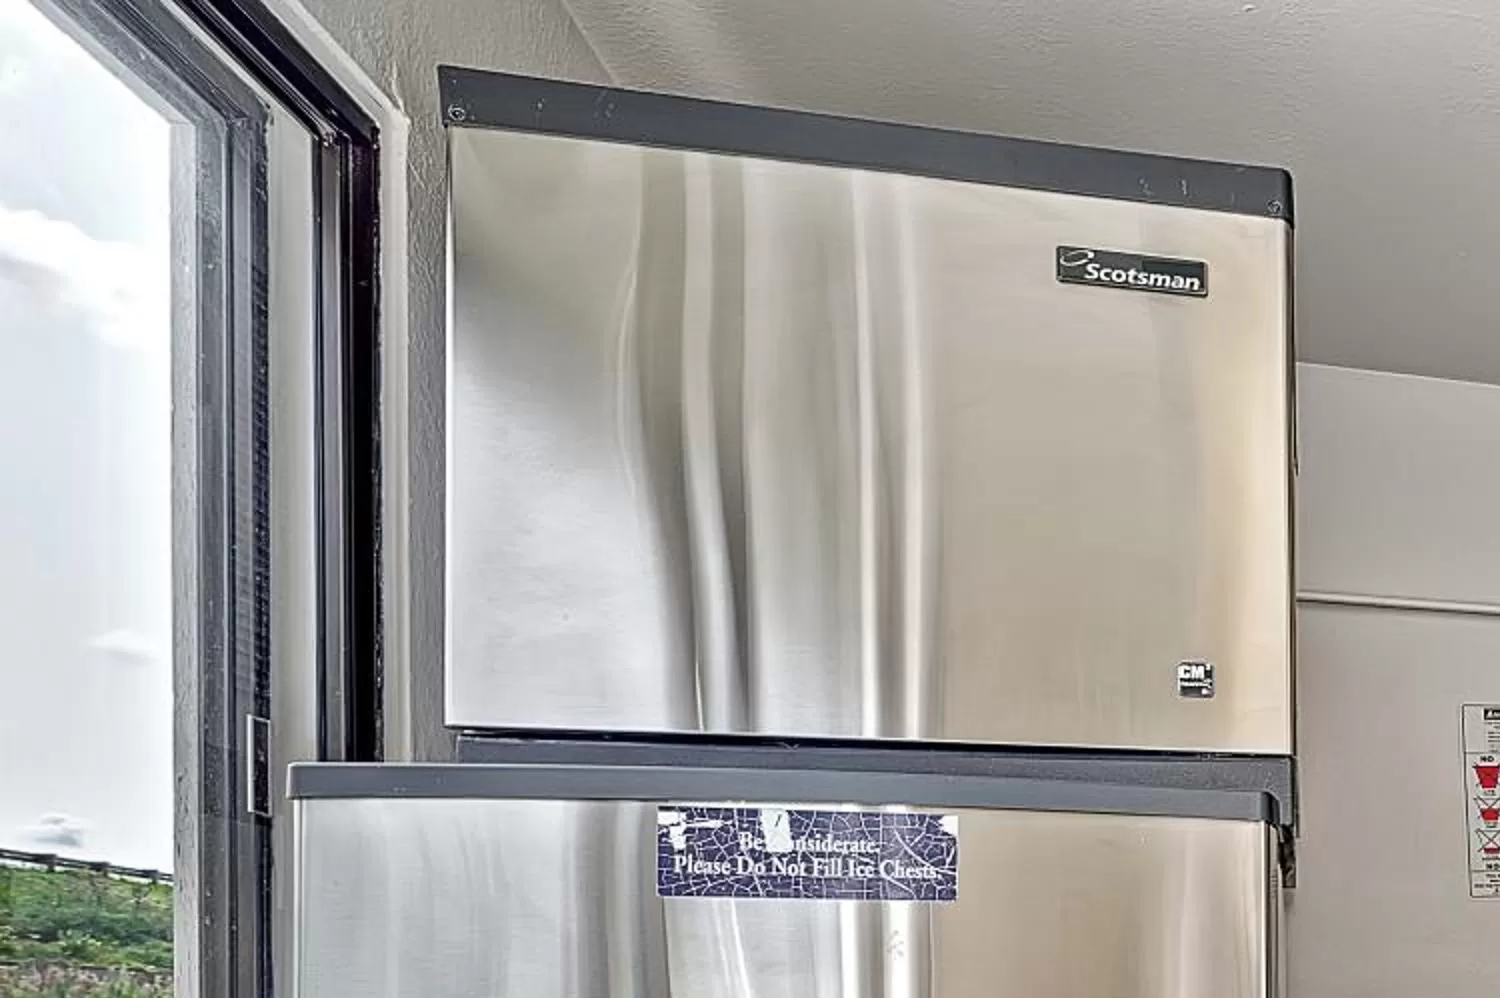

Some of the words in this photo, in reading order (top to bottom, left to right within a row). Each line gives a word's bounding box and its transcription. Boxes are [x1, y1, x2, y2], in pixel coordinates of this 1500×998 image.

[1084, 263, 1200, 291] Scotsman
[739, 833, 762, 852] Be
[673, 853, 731, 875] Please
[737, 855, 766, 876] Do
[771, 855, 806, 877] Not
[812, 856, 843, 878] Fill
[848, 858, 874, 878] Ice
